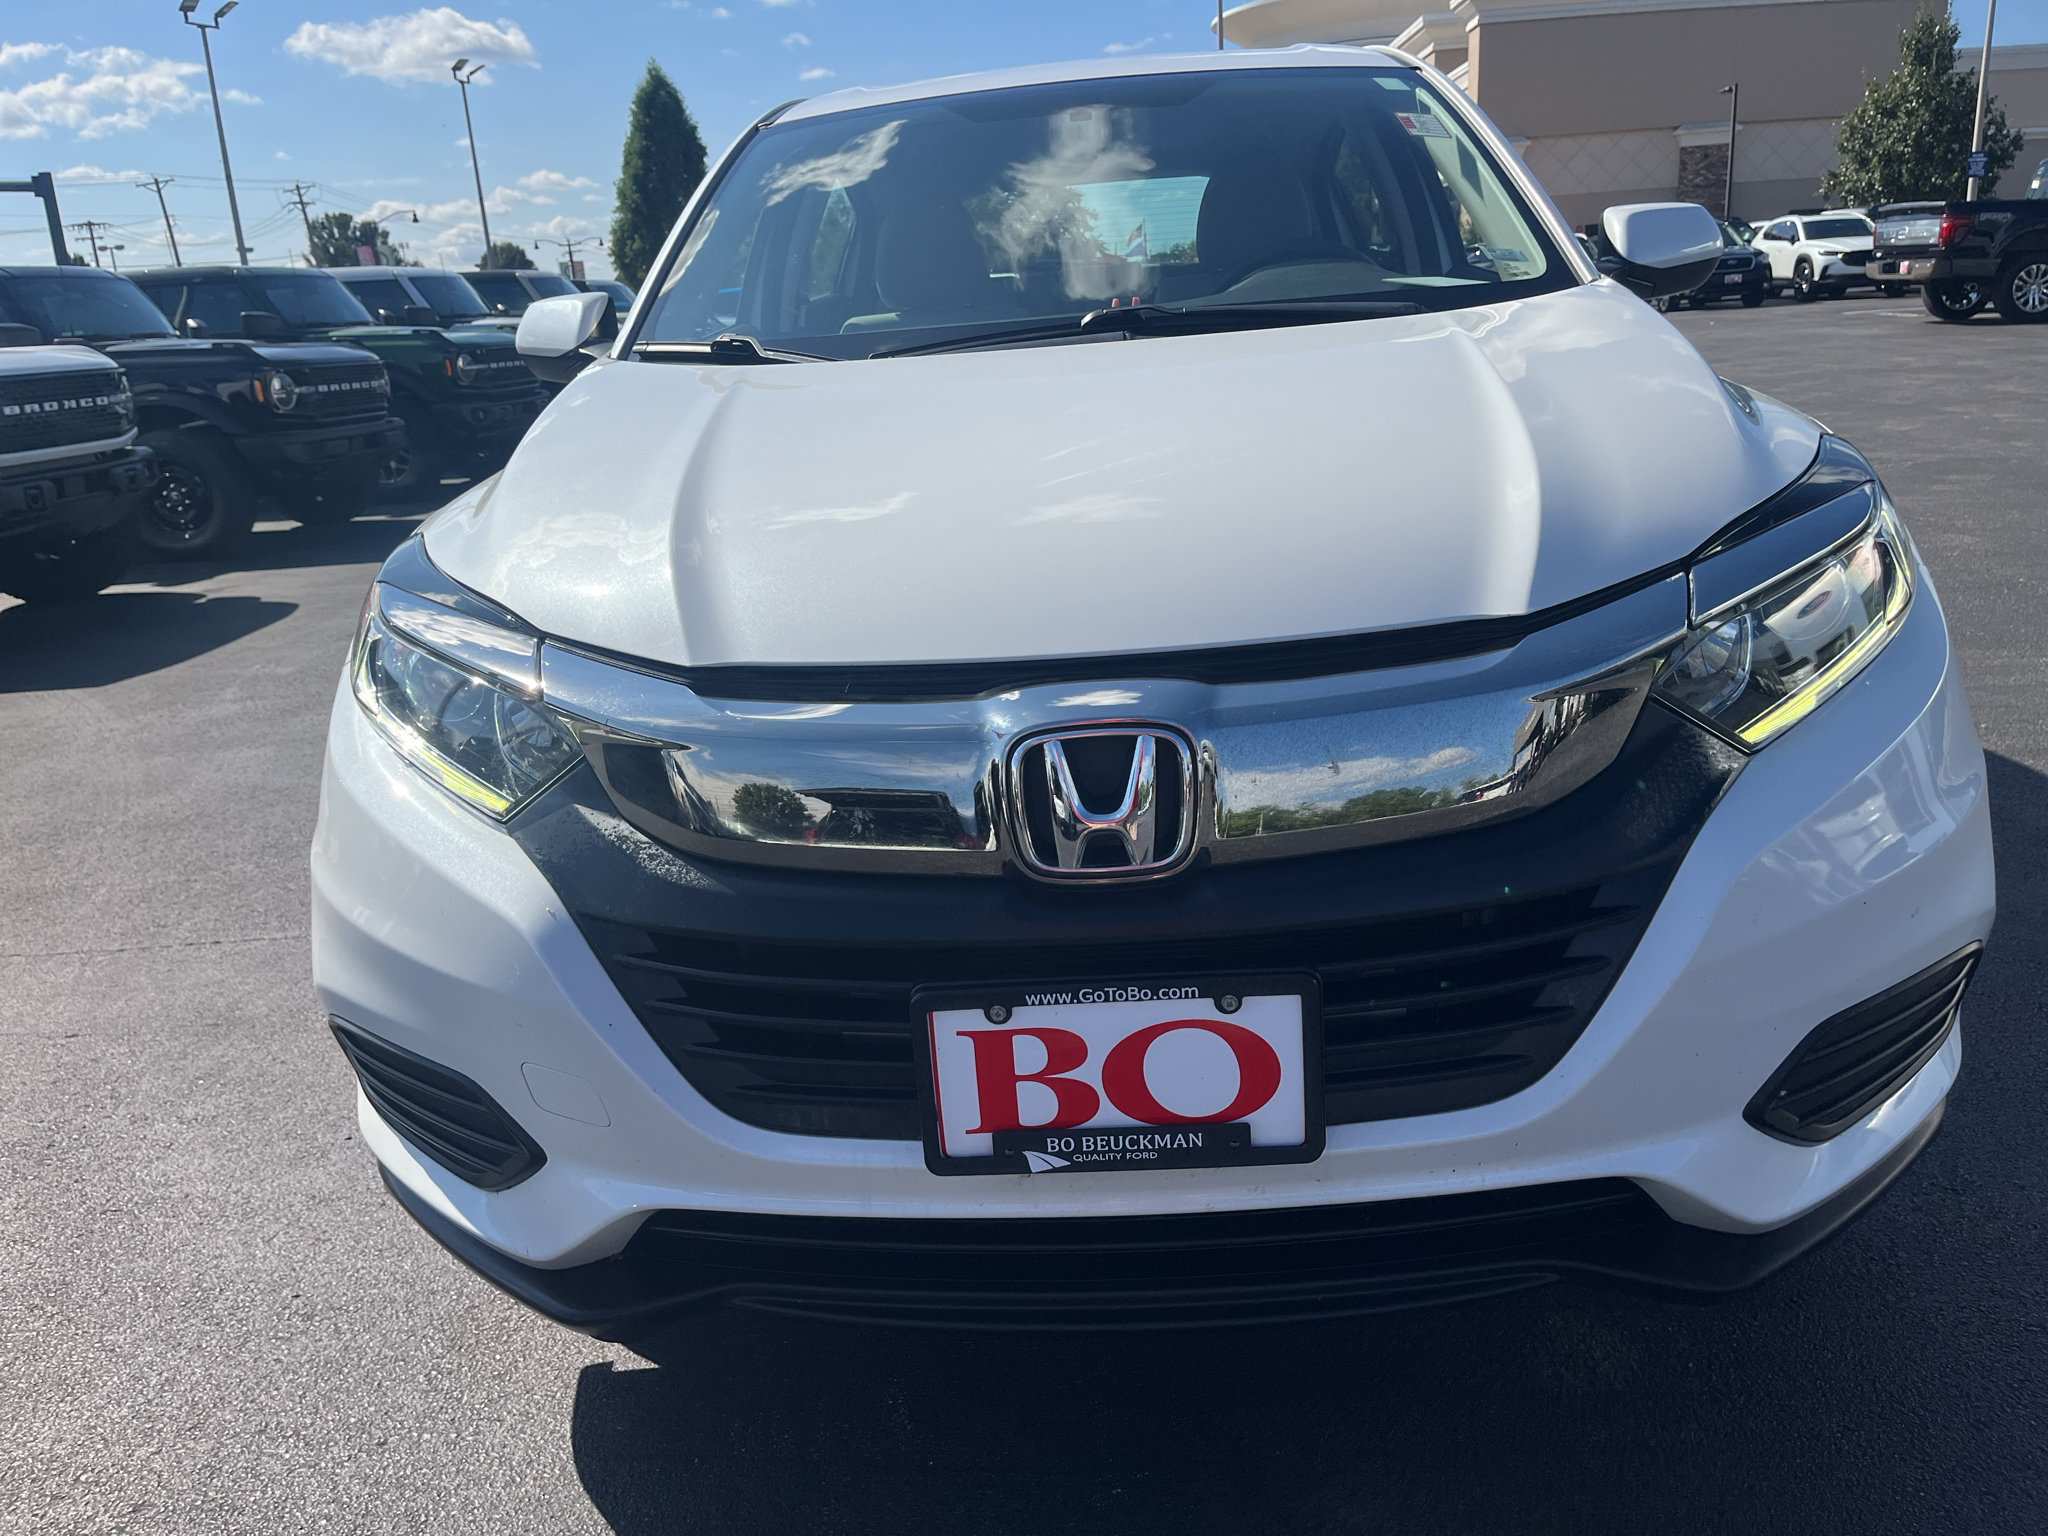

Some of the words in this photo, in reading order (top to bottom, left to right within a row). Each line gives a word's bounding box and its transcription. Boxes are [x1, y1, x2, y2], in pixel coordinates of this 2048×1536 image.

[490, 361, 526, 369] BRON
[317, 380, 379, 392] BRONCO
[2, 396, 109, 416] BRONCO
[1025, 986, 1199, 1006] www.GoToBo.com
[956, 1018, 1282, 1135] BO
[1046, 1137, 1075, 1153] BO
[1081, 1132, 1203, 1151] BEUCKMAN
[1072, 1152, 1122, 1163] QUALITY
[1126, 1151, 1158, 1161] FORD
